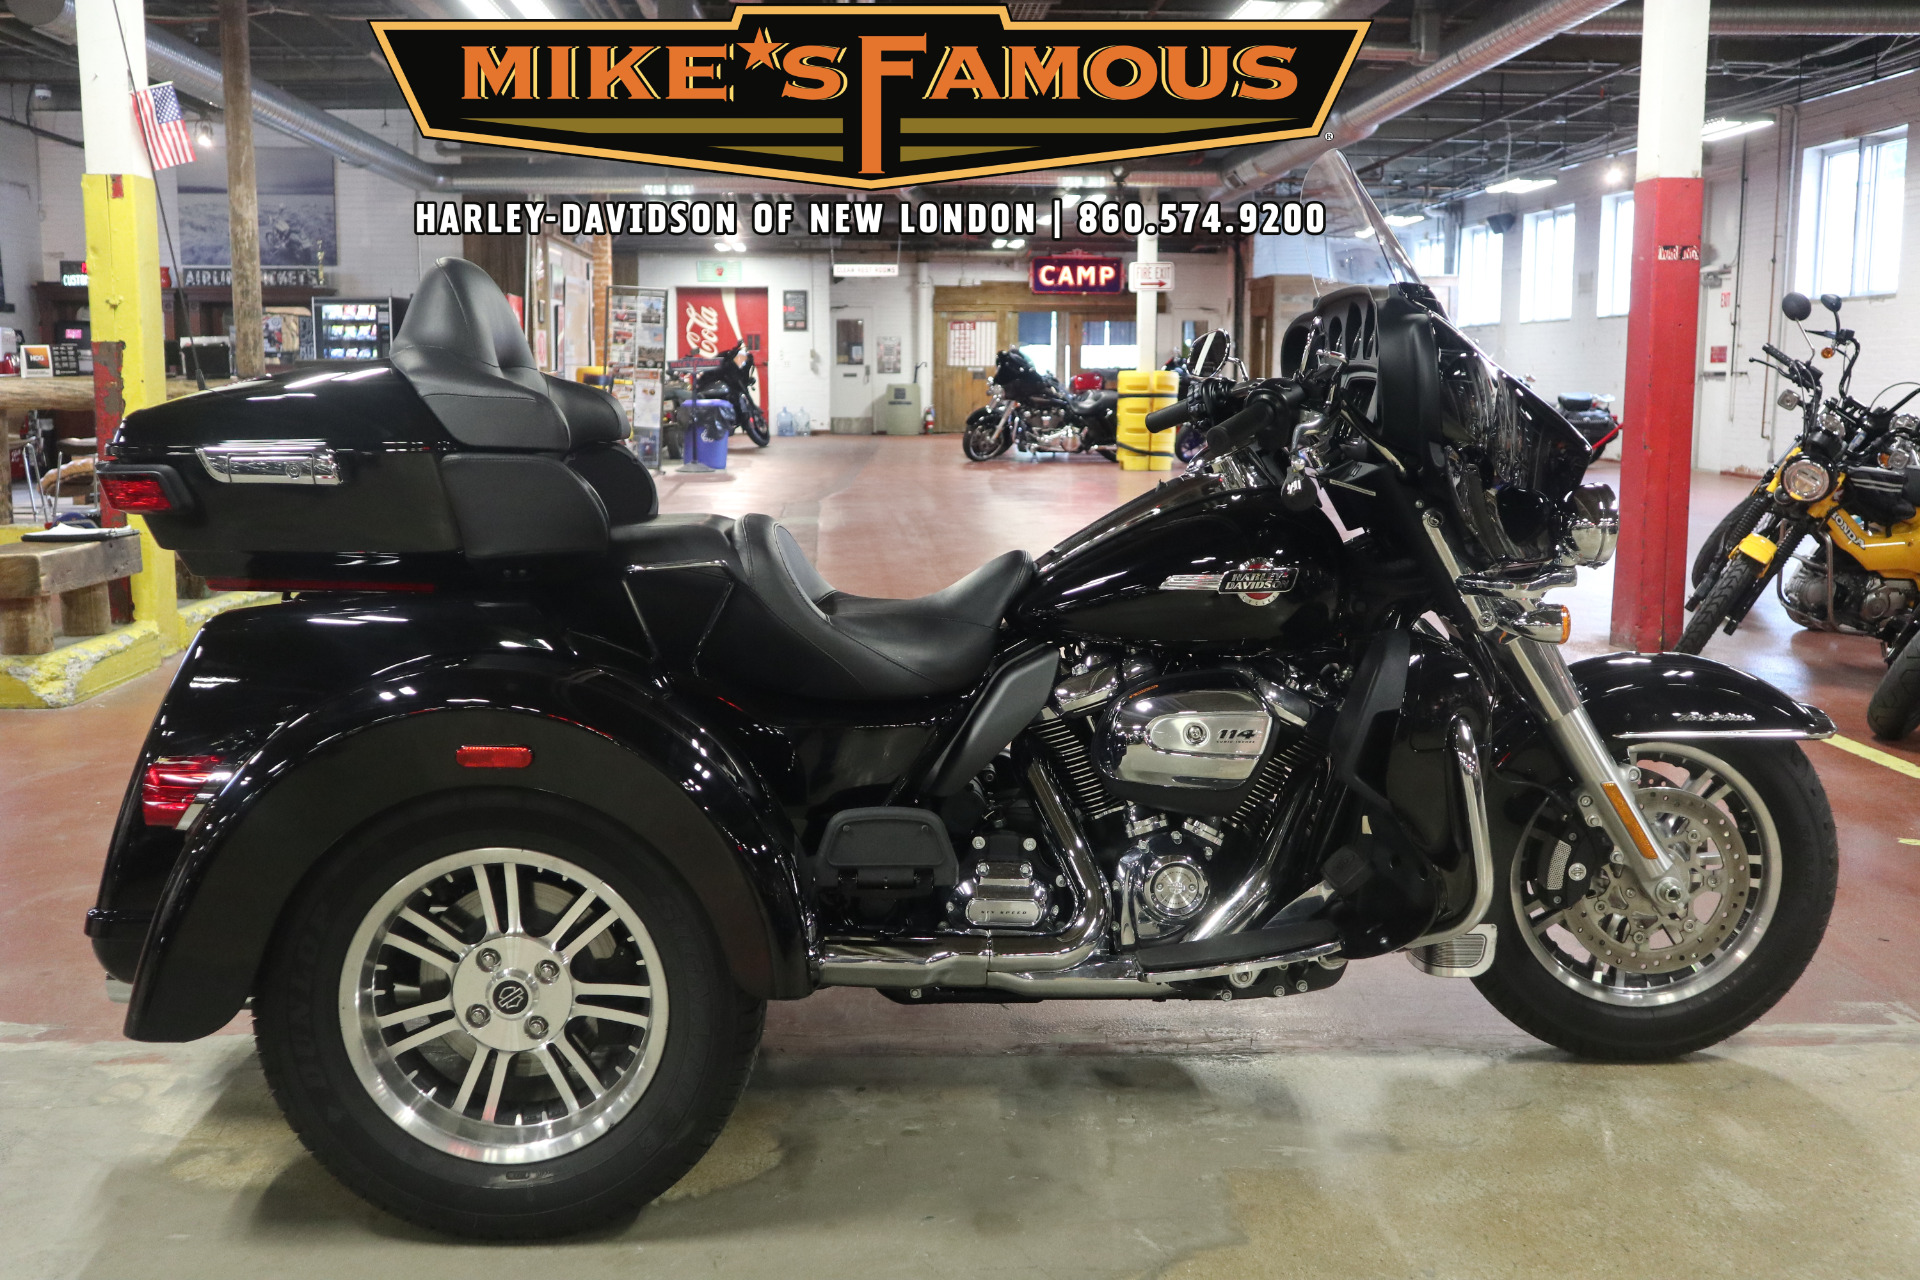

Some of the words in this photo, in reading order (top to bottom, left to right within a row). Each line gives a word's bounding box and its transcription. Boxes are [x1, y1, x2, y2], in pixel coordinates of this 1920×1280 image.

[1039, 264, 1116, 287] CAMP
[1137, 266, 1152, 280] FIRE
[1155, 266, 1171, 280] EXIT
[685, 301, 719, 359] Cola
[1219, 729, 1256, 739] 114
